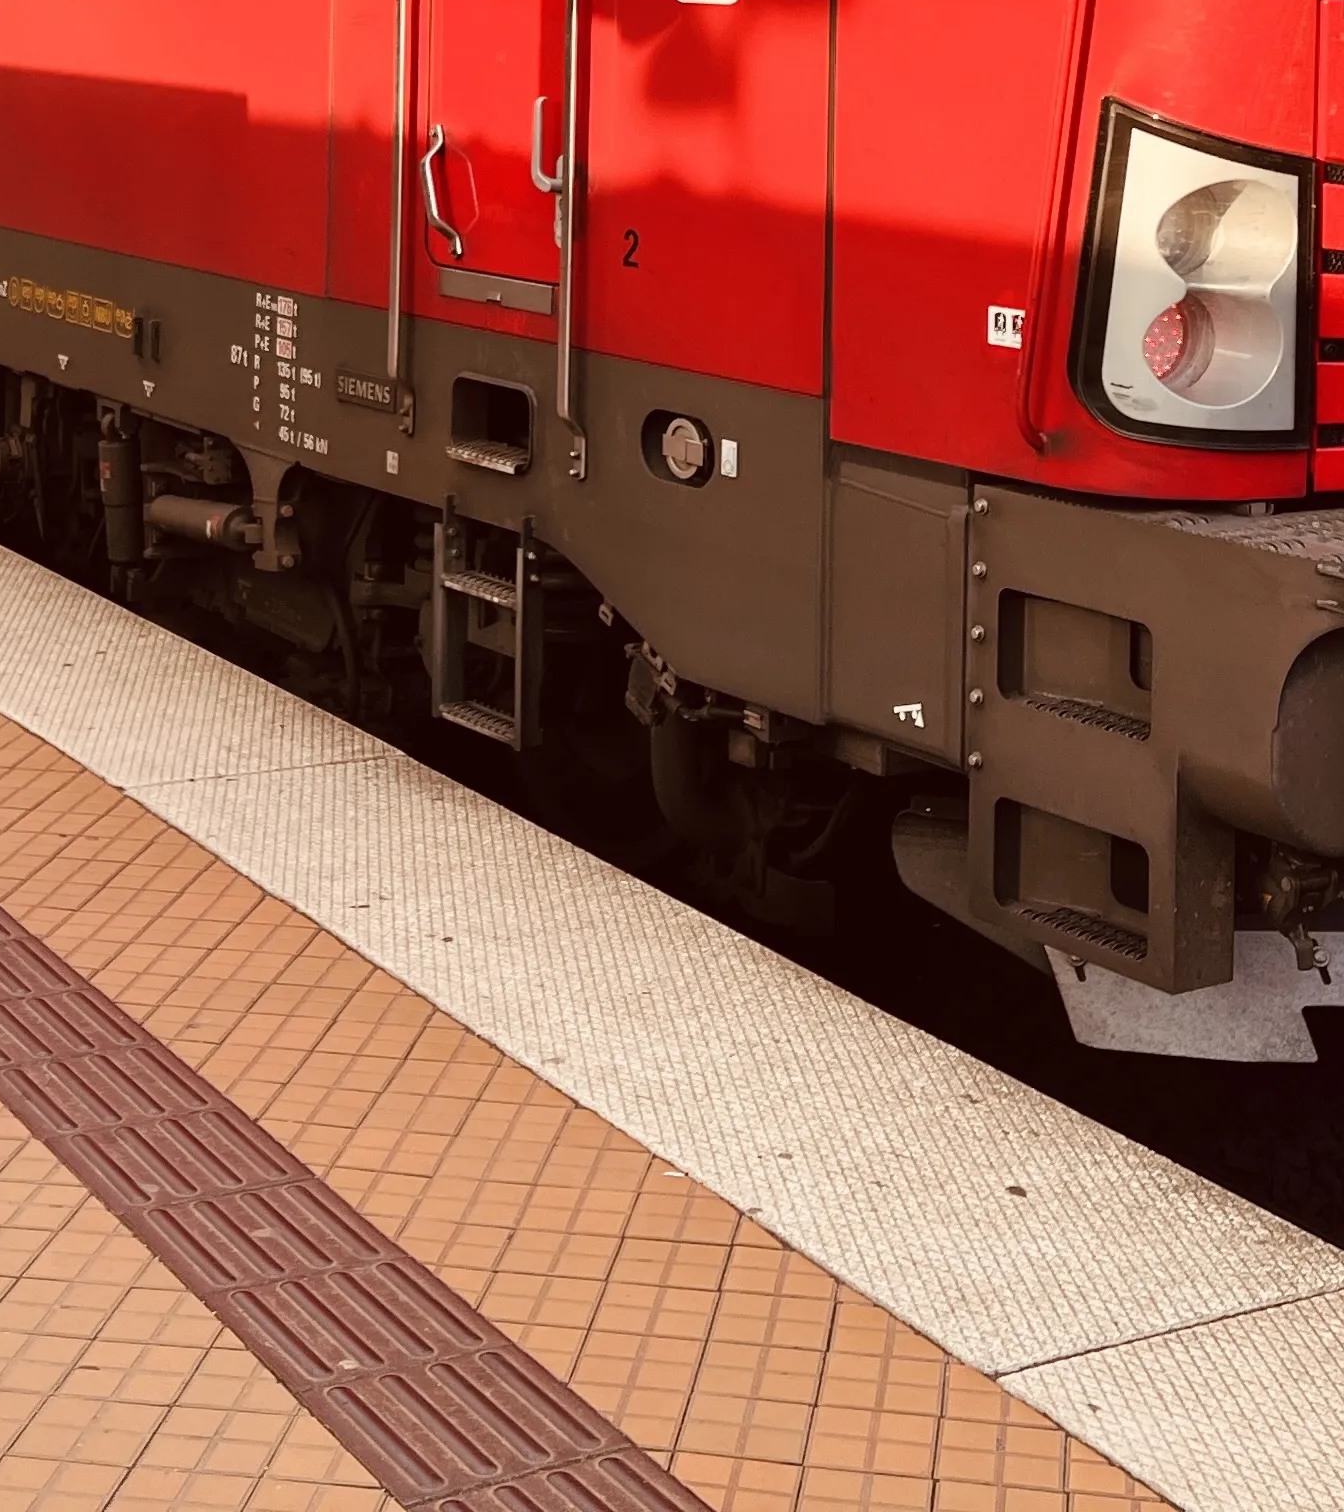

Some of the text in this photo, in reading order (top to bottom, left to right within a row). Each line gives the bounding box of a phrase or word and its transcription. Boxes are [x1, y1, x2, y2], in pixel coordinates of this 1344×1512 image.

[622, 229, 640, 269] 2
[254, 354, 260, 370] R
[253, 375, 260, 390] P
[336, 375, 391, 404] SIEMENS
[253, 396, 260, 412] G
